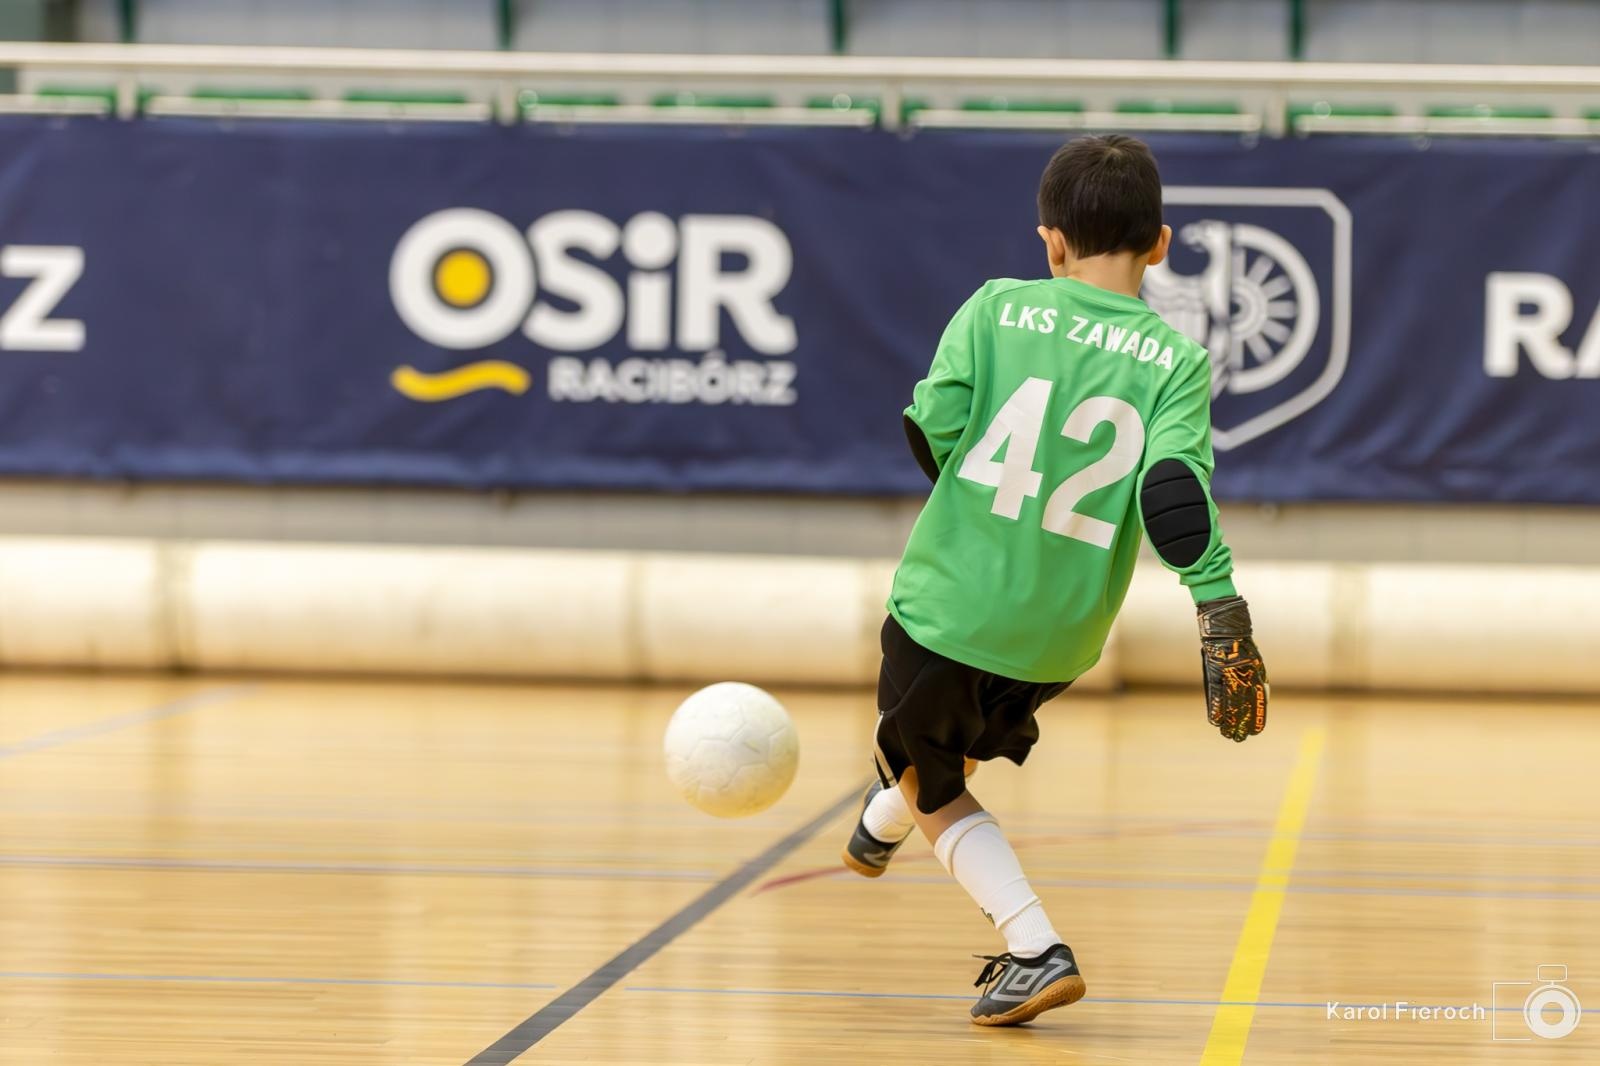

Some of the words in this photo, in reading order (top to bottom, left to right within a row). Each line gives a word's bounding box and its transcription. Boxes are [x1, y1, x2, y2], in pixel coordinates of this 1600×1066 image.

[998, 303, 1058, 334] LKS
[1066, 315, 1174, 370] ZAWADA
[1483, 271, 1600, 380] R
[547, 350, 797, 405] RACIBÓRZ
[957, 376, 1146, 550] 42
